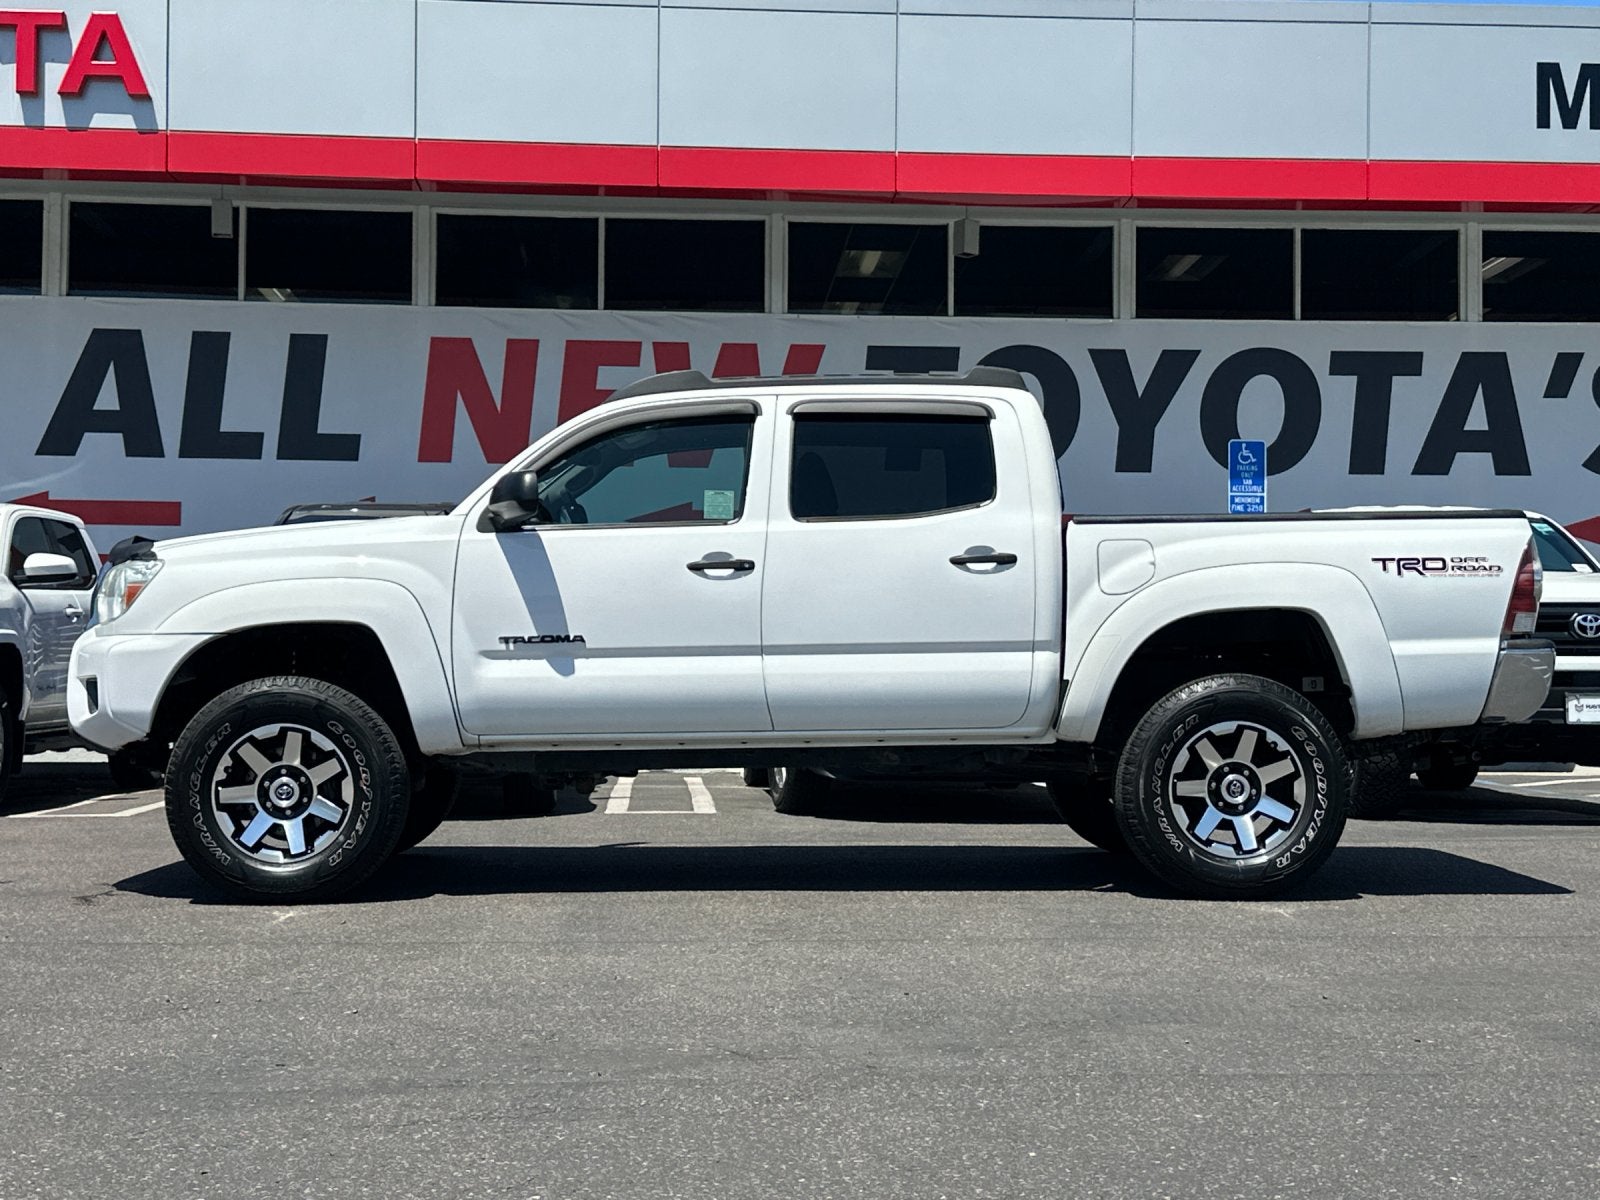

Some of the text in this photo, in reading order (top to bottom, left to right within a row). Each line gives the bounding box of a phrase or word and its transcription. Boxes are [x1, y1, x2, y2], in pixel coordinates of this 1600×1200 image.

[0, 11, 152, 98] TA
[35, 328, 361, 462] ALL
[865, 344, 1600, 478] OYOTA'
[1371, 557, 1447, 577] TRD
[1450, 556, 1488, 564] OFF
[1451, 564, 1502, 573] ROAD
[498, 634, 586, 645] TACOMA
[189, 722, 233, 867] WRANGLER
[326, 720, 374, 867] GOODYEAR
[1151, 713, 1200, 853] WRANGLER
[1275, 725, 1329, 869] GOODYEAR
